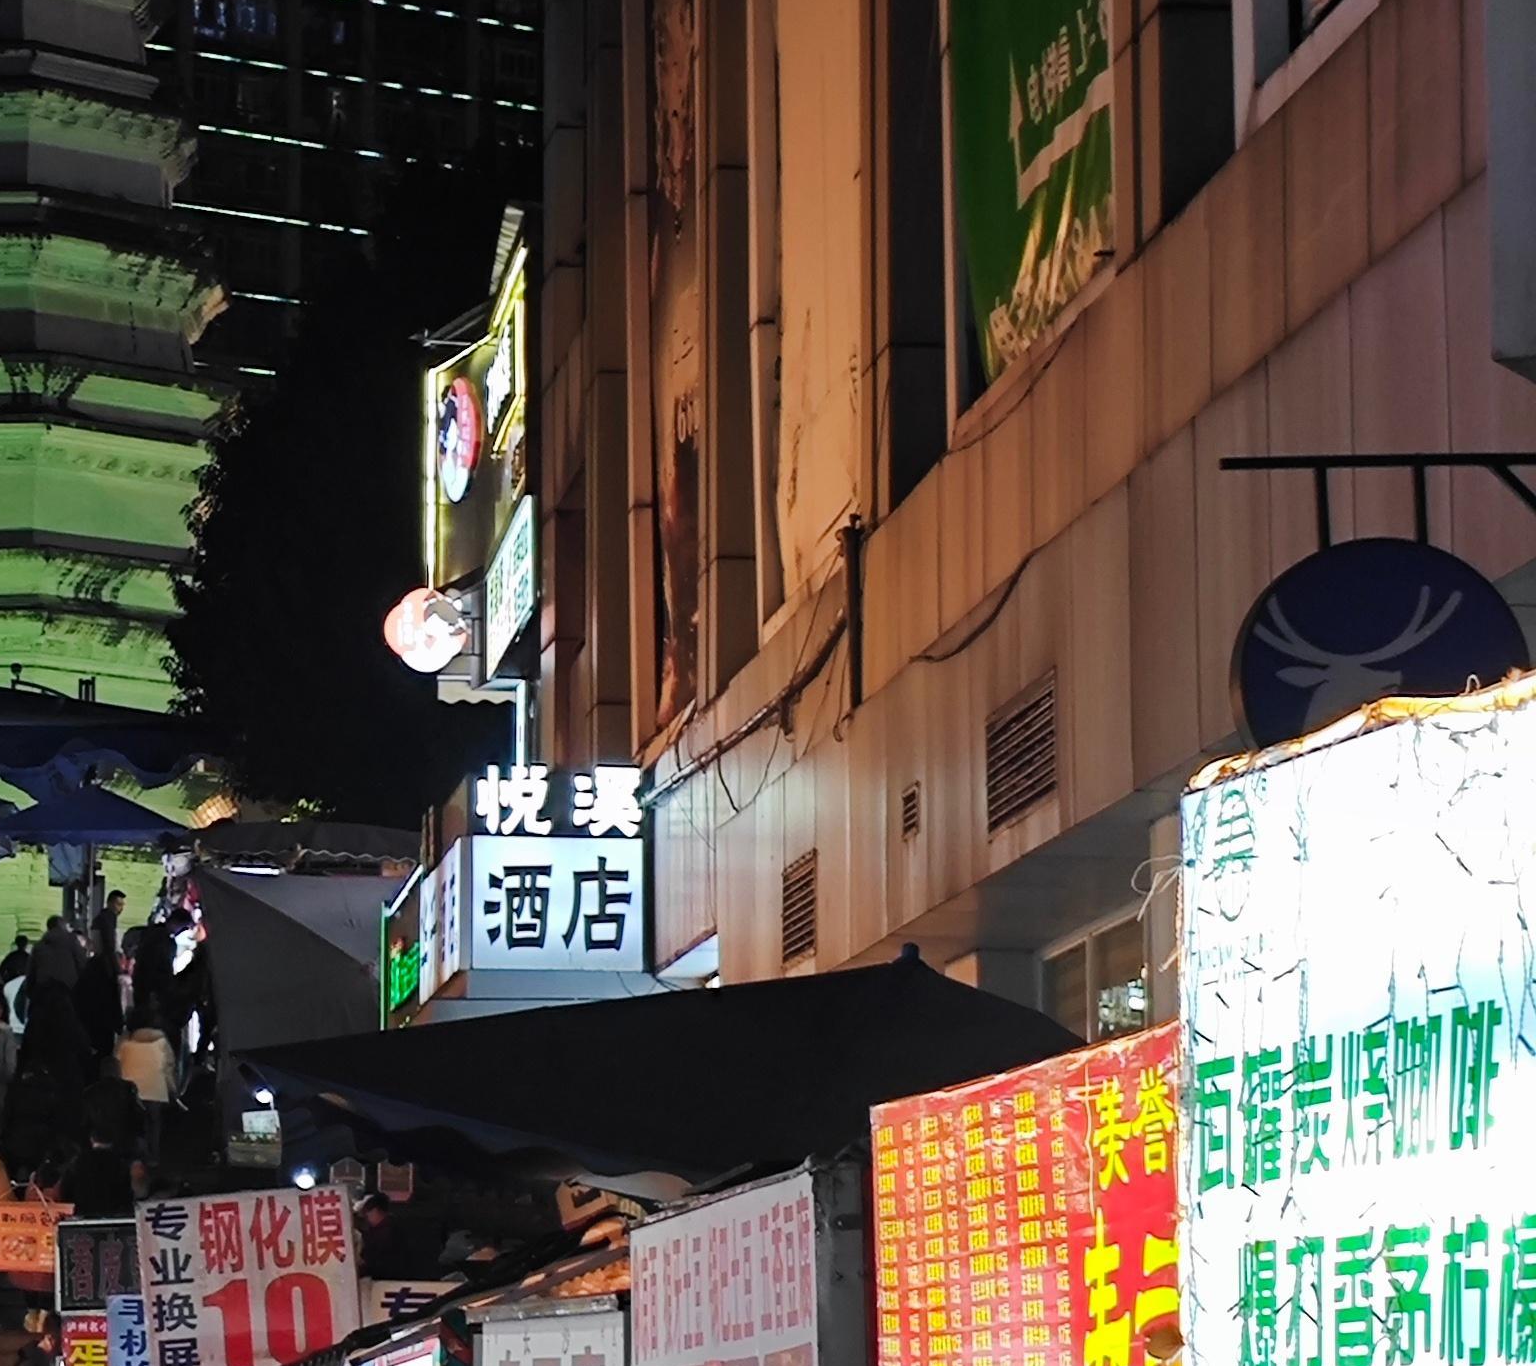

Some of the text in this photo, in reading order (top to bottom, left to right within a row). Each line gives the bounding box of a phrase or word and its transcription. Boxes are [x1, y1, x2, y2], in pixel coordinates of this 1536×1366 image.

[483, 855, 632, 953] 酒店
[198, 1190, 346, 1275] 钢化膜
